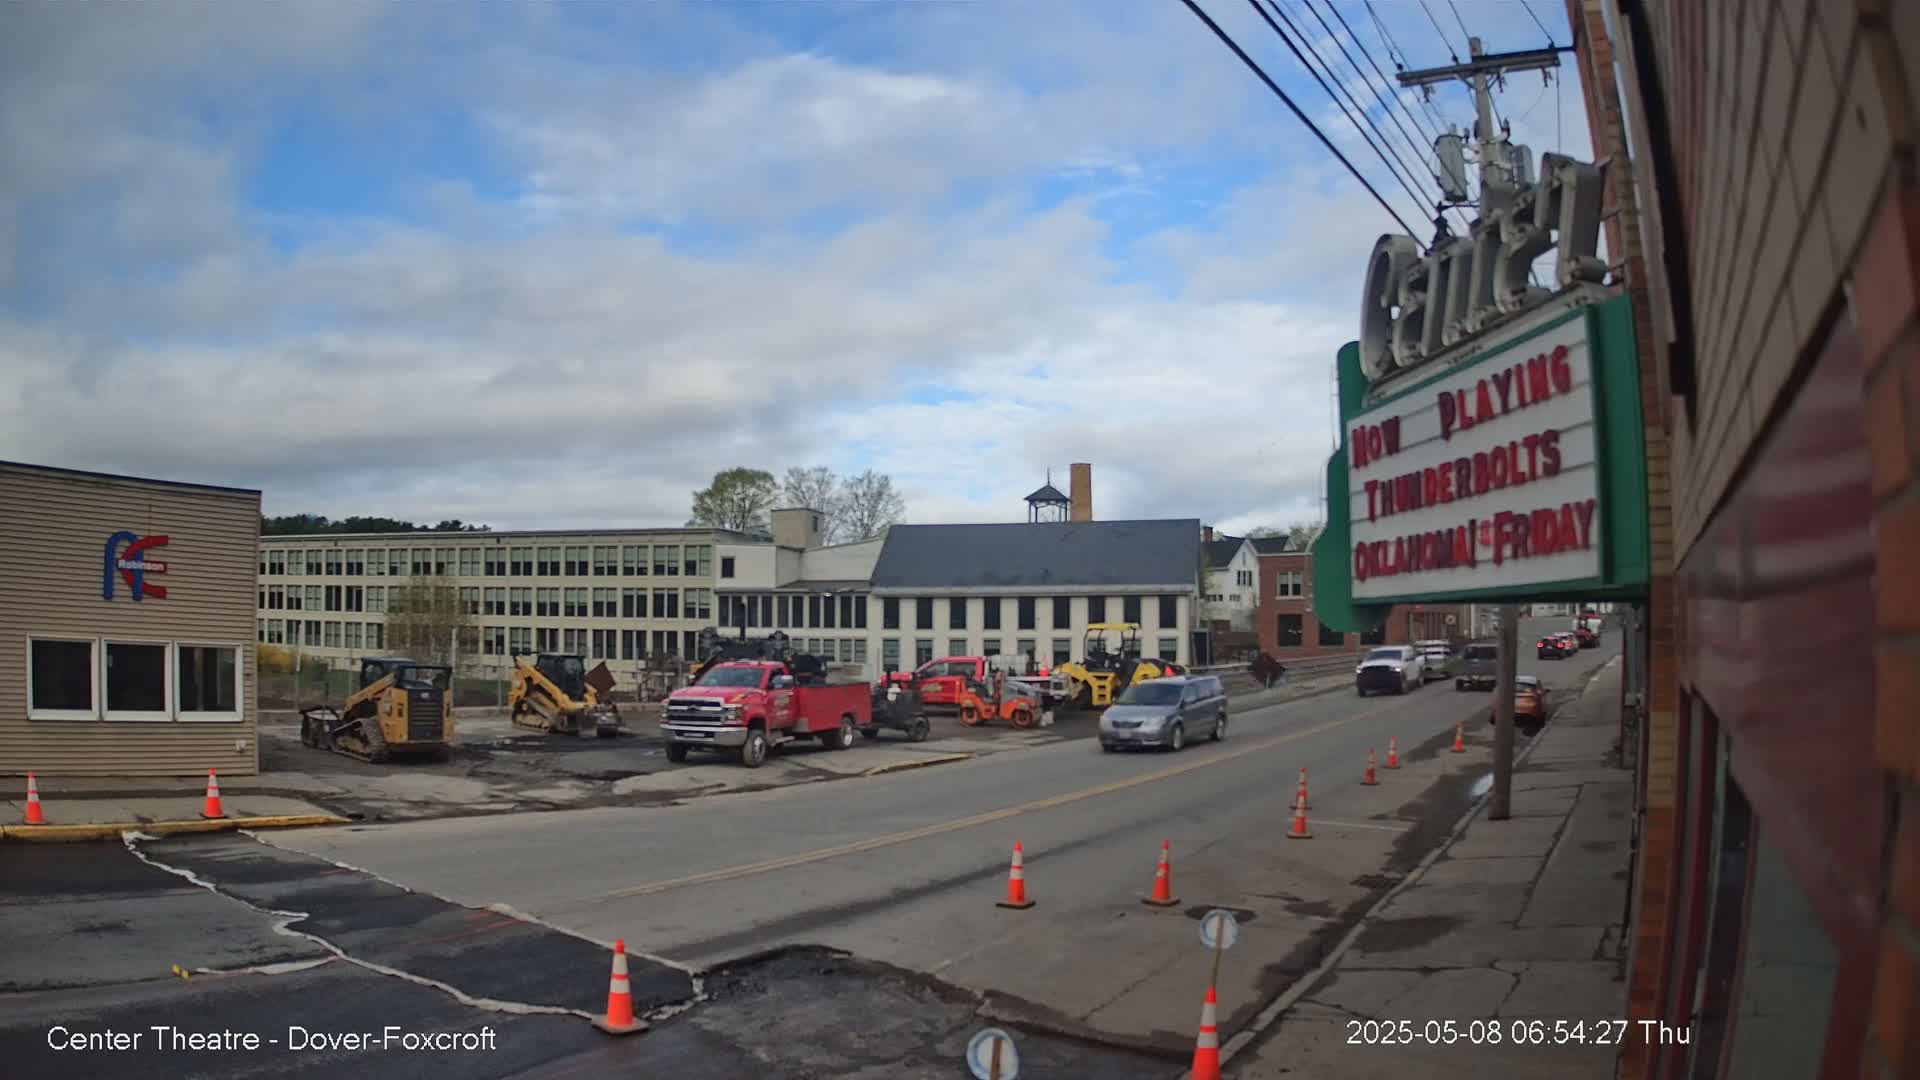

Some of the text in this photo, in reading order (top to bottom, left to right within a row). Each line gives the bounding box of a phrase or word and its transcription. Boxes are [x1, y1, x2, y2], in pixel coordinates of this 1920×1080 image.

[1352, 345, 1571, 469] NOW PLAYING
[1364, 429, 1561, 523] THUNDERBOLTS
[1493, 498, 1596, 566] FRIDAY
